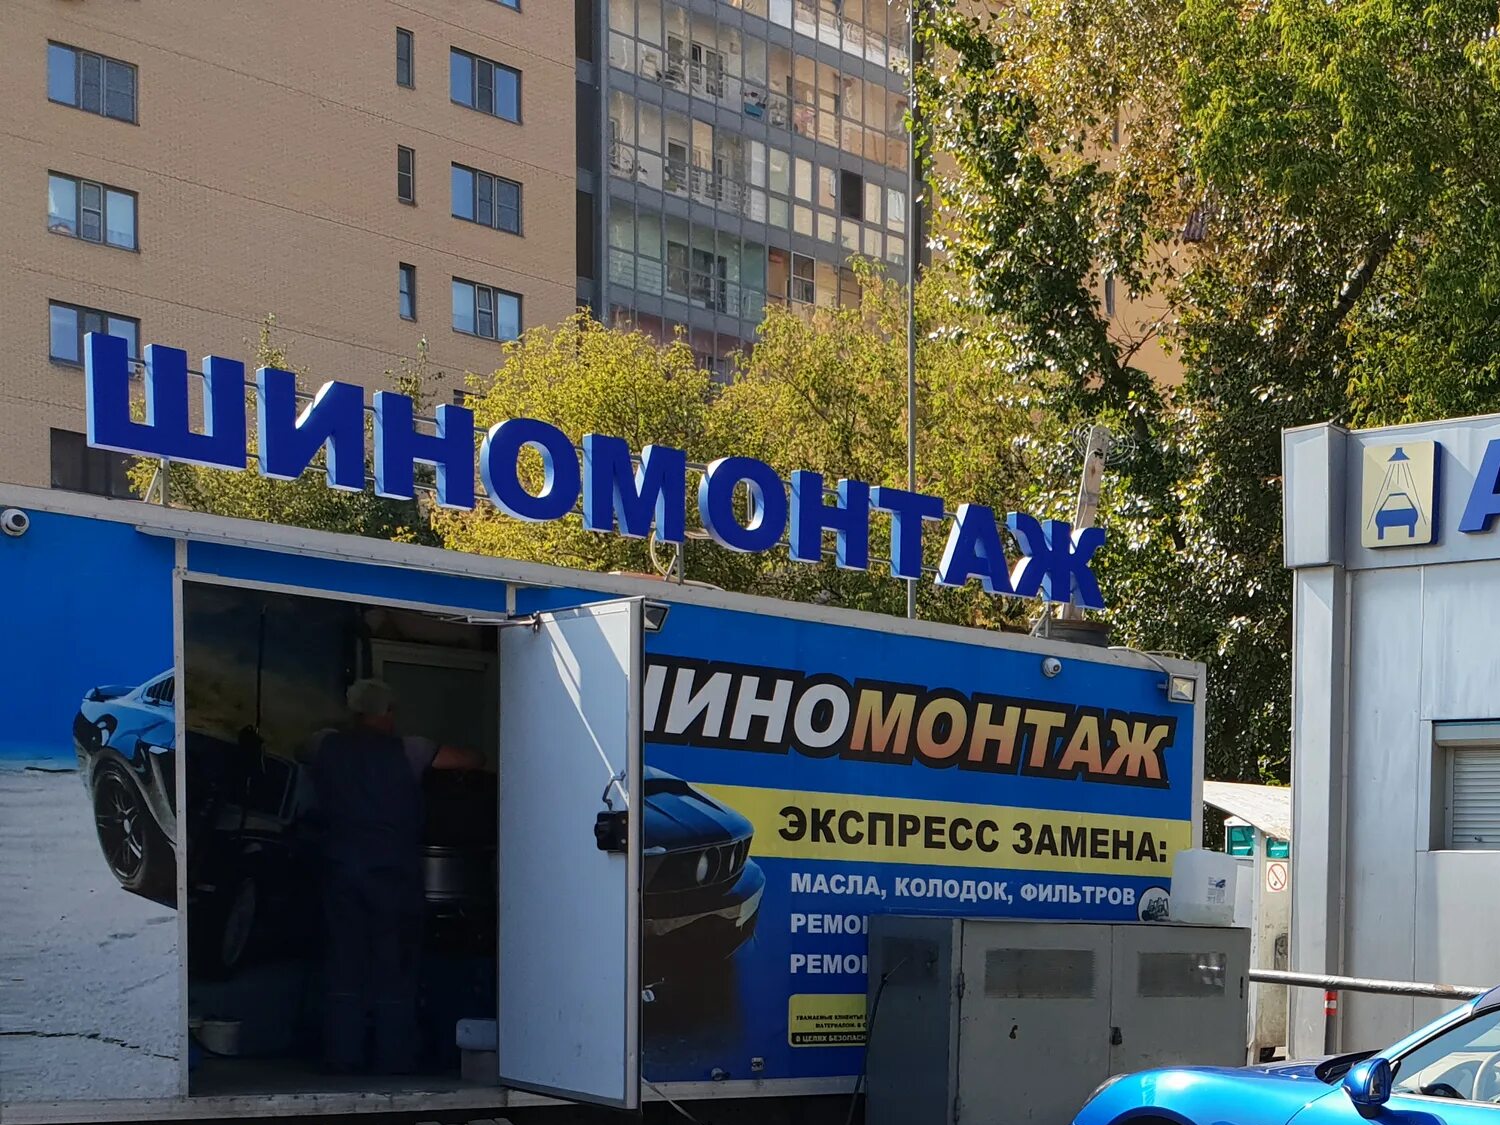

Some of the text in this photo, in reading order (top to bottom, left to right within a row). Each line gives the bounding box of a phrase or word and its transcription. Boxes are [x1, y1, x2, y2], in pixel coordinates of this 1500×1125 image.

[84, 331, 1106, 610] ШИНОМОНТАЖ
[778, 806, 1167, 863] ЭКСПРЕСС ЗАМЕНА:
[791, 872, 1135, 906] МАСЛА, КОЛОДОК, ФИЛЬТРОВ
